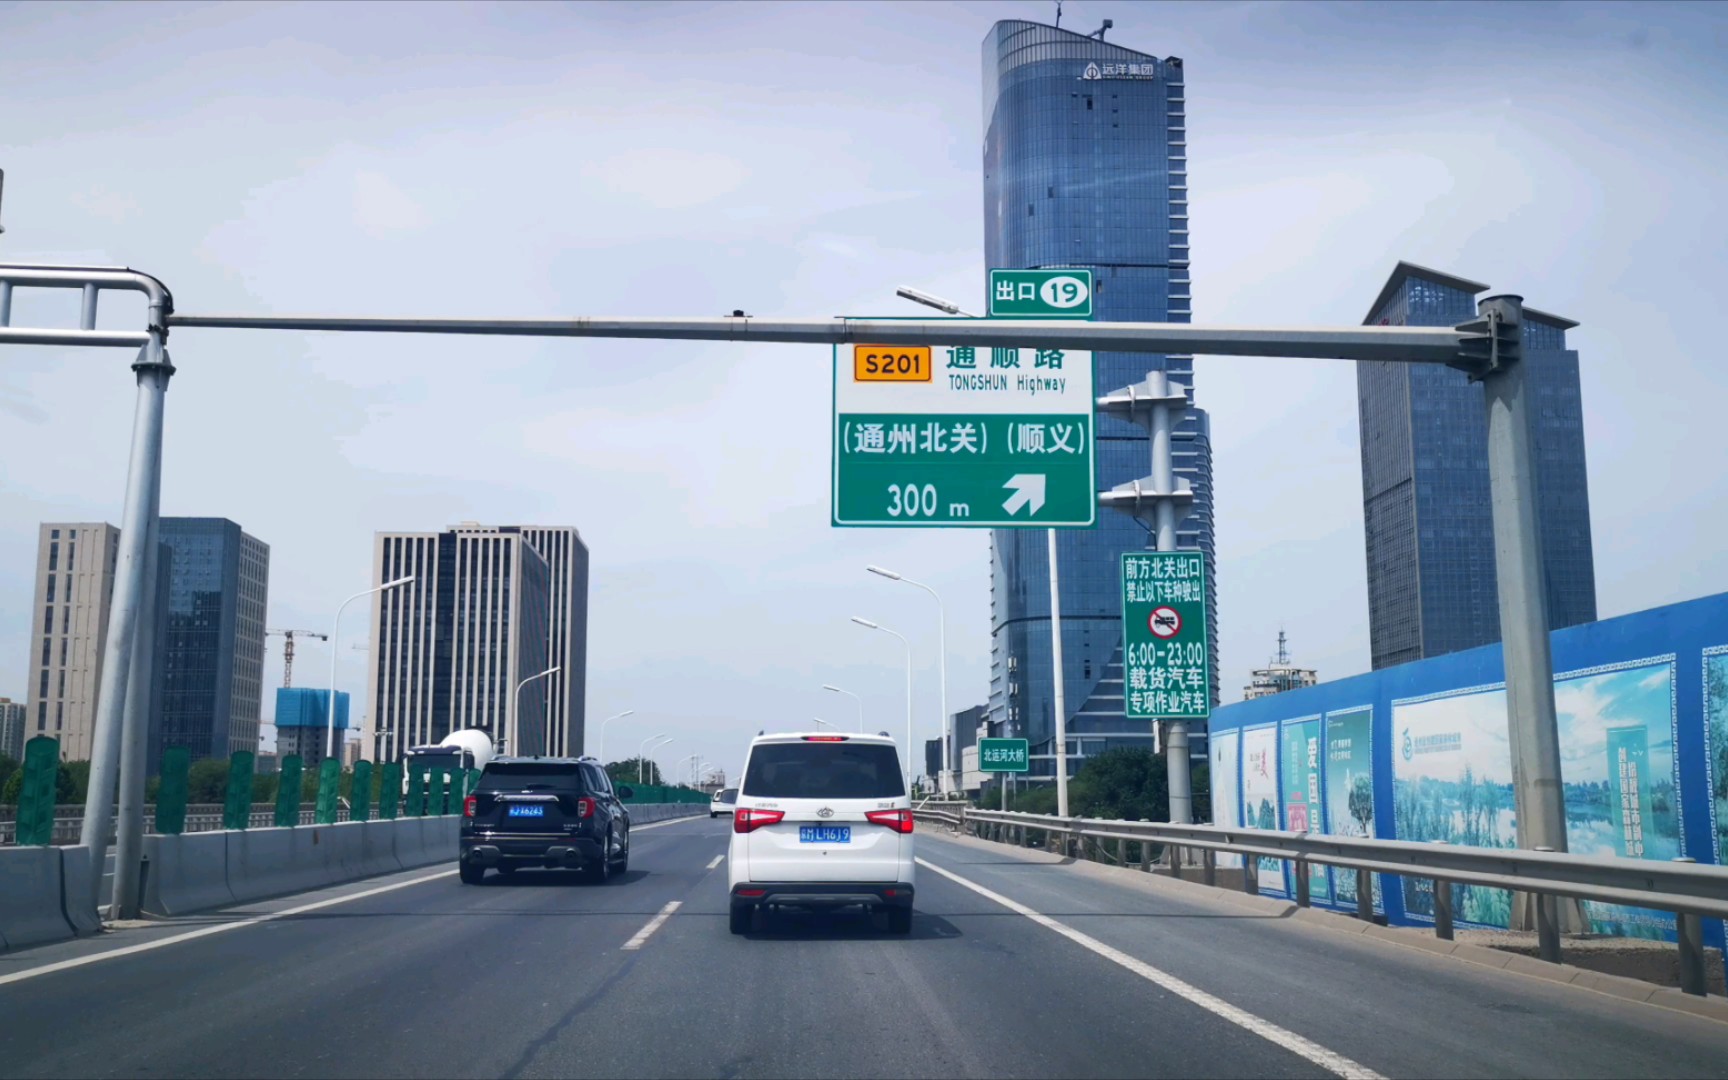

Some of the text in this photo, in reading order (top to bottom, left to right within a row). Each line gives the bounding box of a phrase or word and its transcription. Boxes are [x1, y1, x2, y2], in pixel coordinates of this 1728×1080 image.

[1102, 63, 1154, 75] 远洋集团
[995, 280, 1079, 303] 出口 19
[865, 354, 920, 374] S201
[946, 346, 1065, 369] 通顺路
[949, 374, 1066, 396] TONGSHUN Highway
[887, 483, 970, 517] 300 m
[1125, 556, 1200, 580] 前方北关出口
[1126, 580, 1201, 603] 禁止以下车种驶出
[1128, 641, 1204, 666] 6:00-23:00
[1129, 666, 1204, 690] 载货汽车
[1130, 690, 1205, 714] 专项作业汽车
[984, 748, 1025, 763] 北运河大桥
